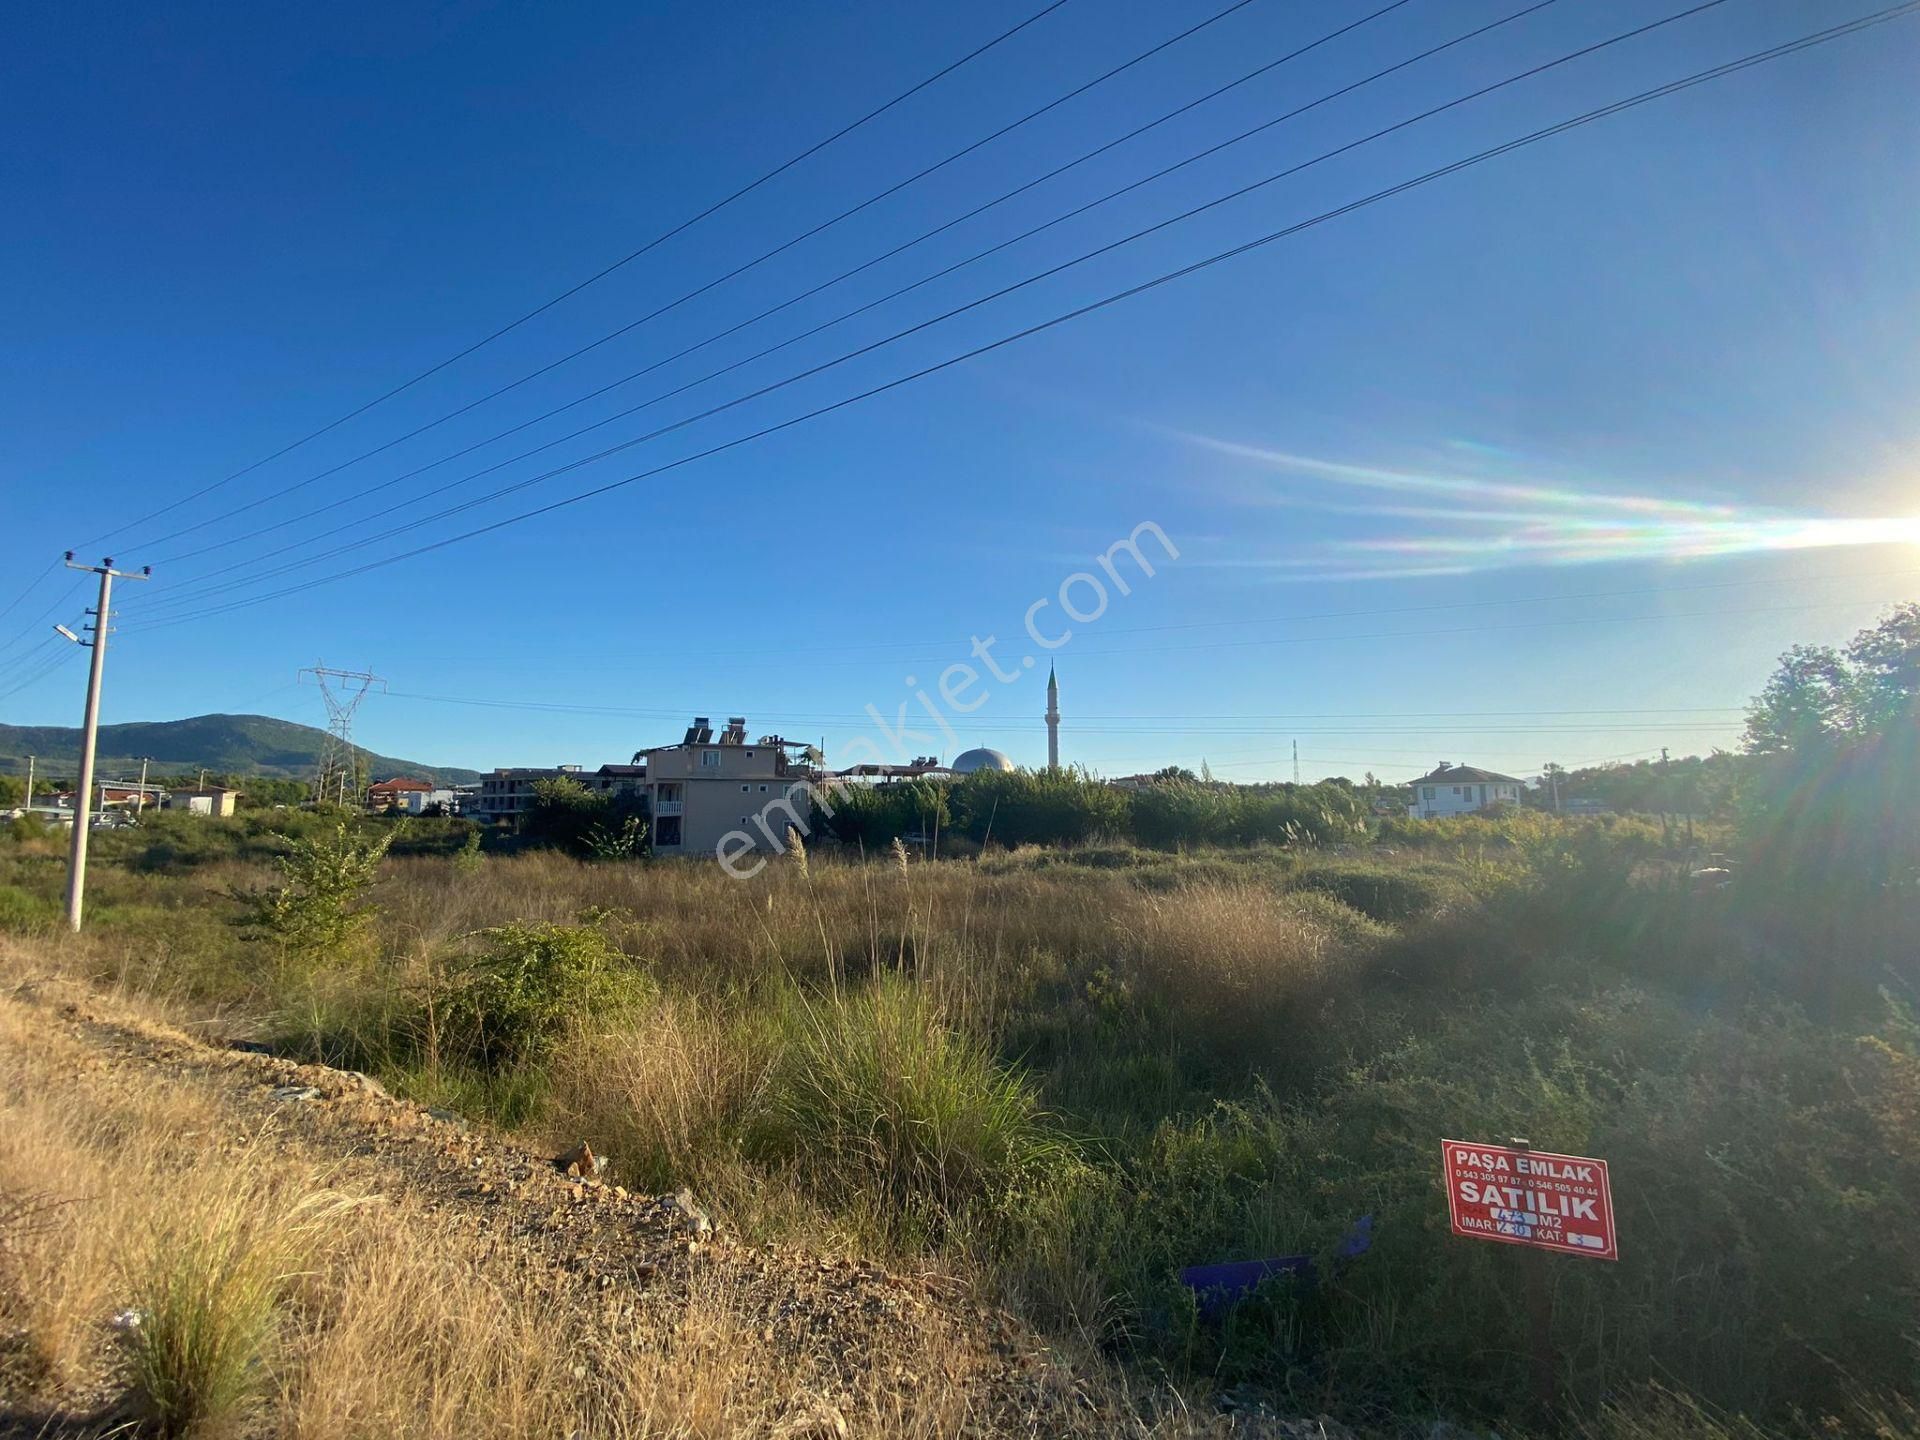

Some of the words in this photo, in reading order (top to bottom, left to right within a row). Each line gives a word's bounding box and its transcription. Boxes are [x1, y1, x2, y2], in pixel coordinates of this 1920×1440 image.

[1455, 1168, 1462, 1178] 0
[1528, 1177, 1535, 1187] 0
[1456, 1151, 1510, 1172] PAŞA
[1516, 1158, 1593, 1183] EMLAK
[1460, 1181, 1599, 1221] SATILIK
[1536, 1229, 1564, 1243] KAT:
